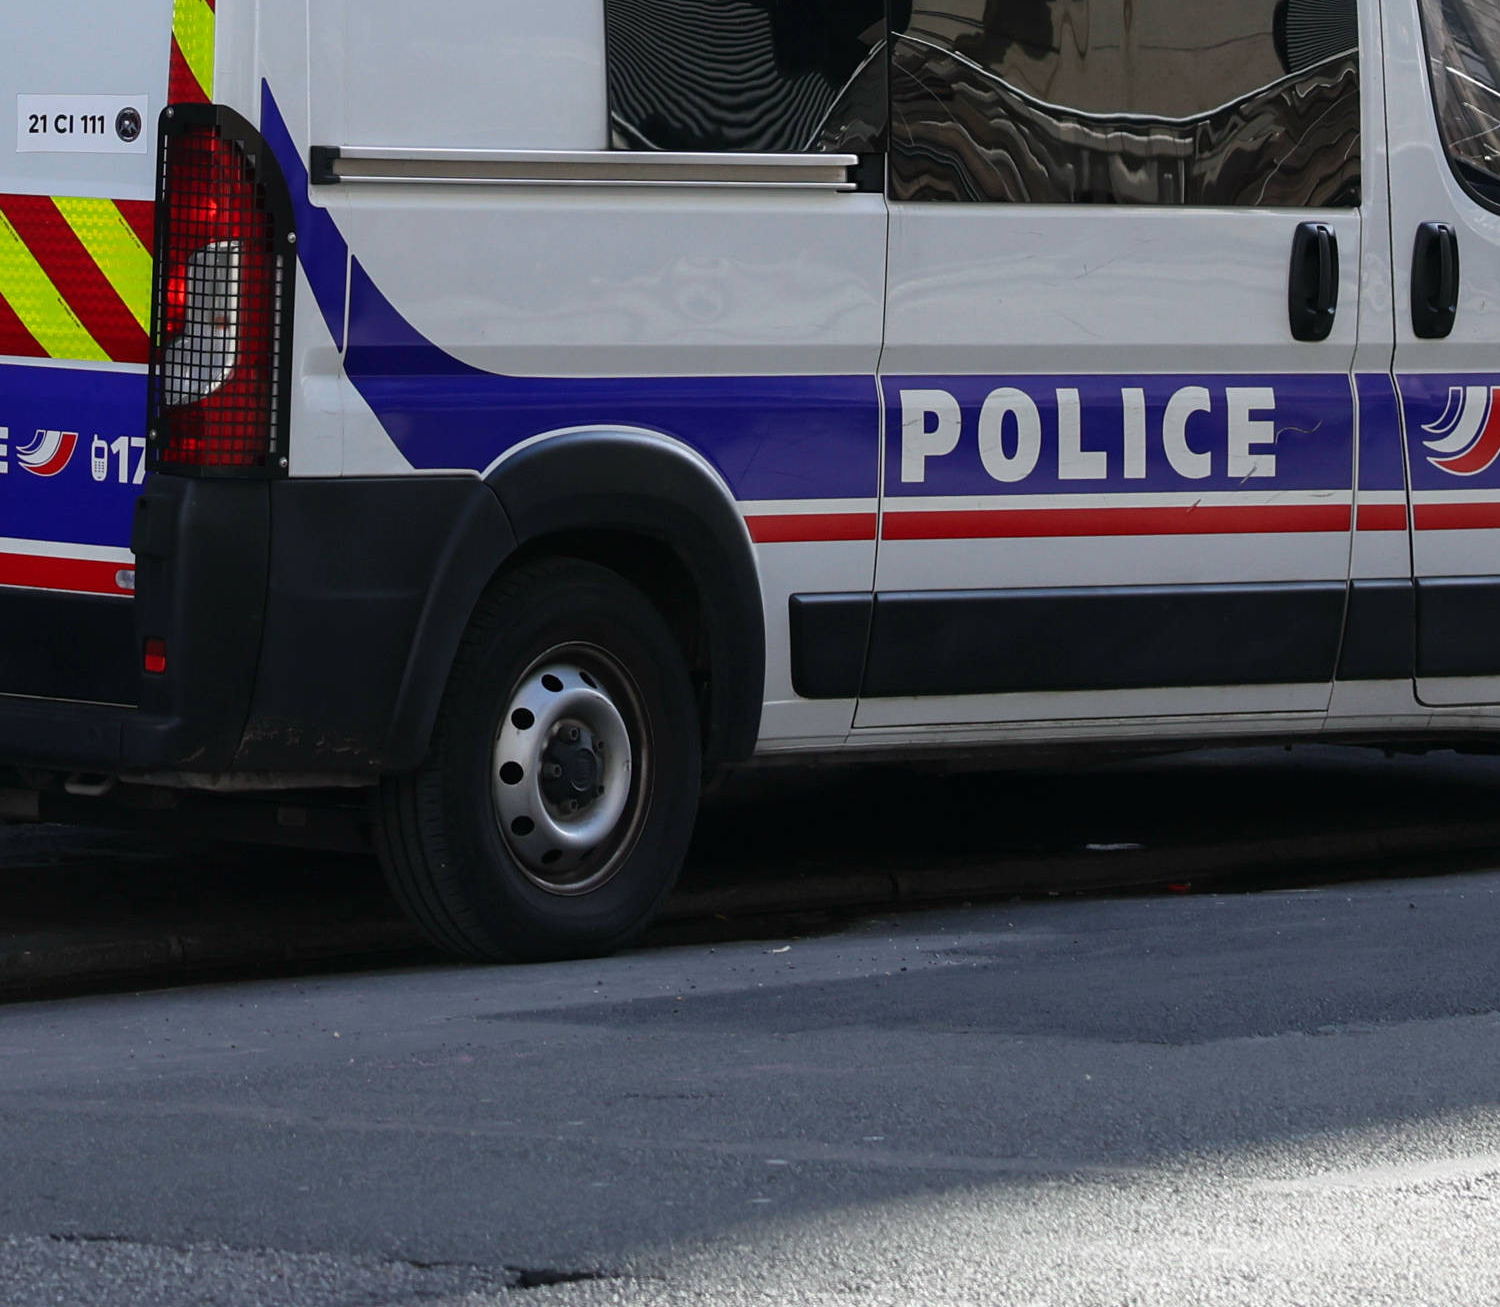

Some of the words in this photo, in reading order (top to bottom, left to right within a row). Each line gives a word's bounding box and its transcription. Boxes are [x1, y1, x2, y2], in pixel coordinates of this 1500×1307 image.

[28, 114, 47, 134] 21
[53, 114, 75, 134] CI
[80, 115, 105, 135] 111
[109, 435, 147, 485] 17
[899, 386, 1277, 485] POLICE
